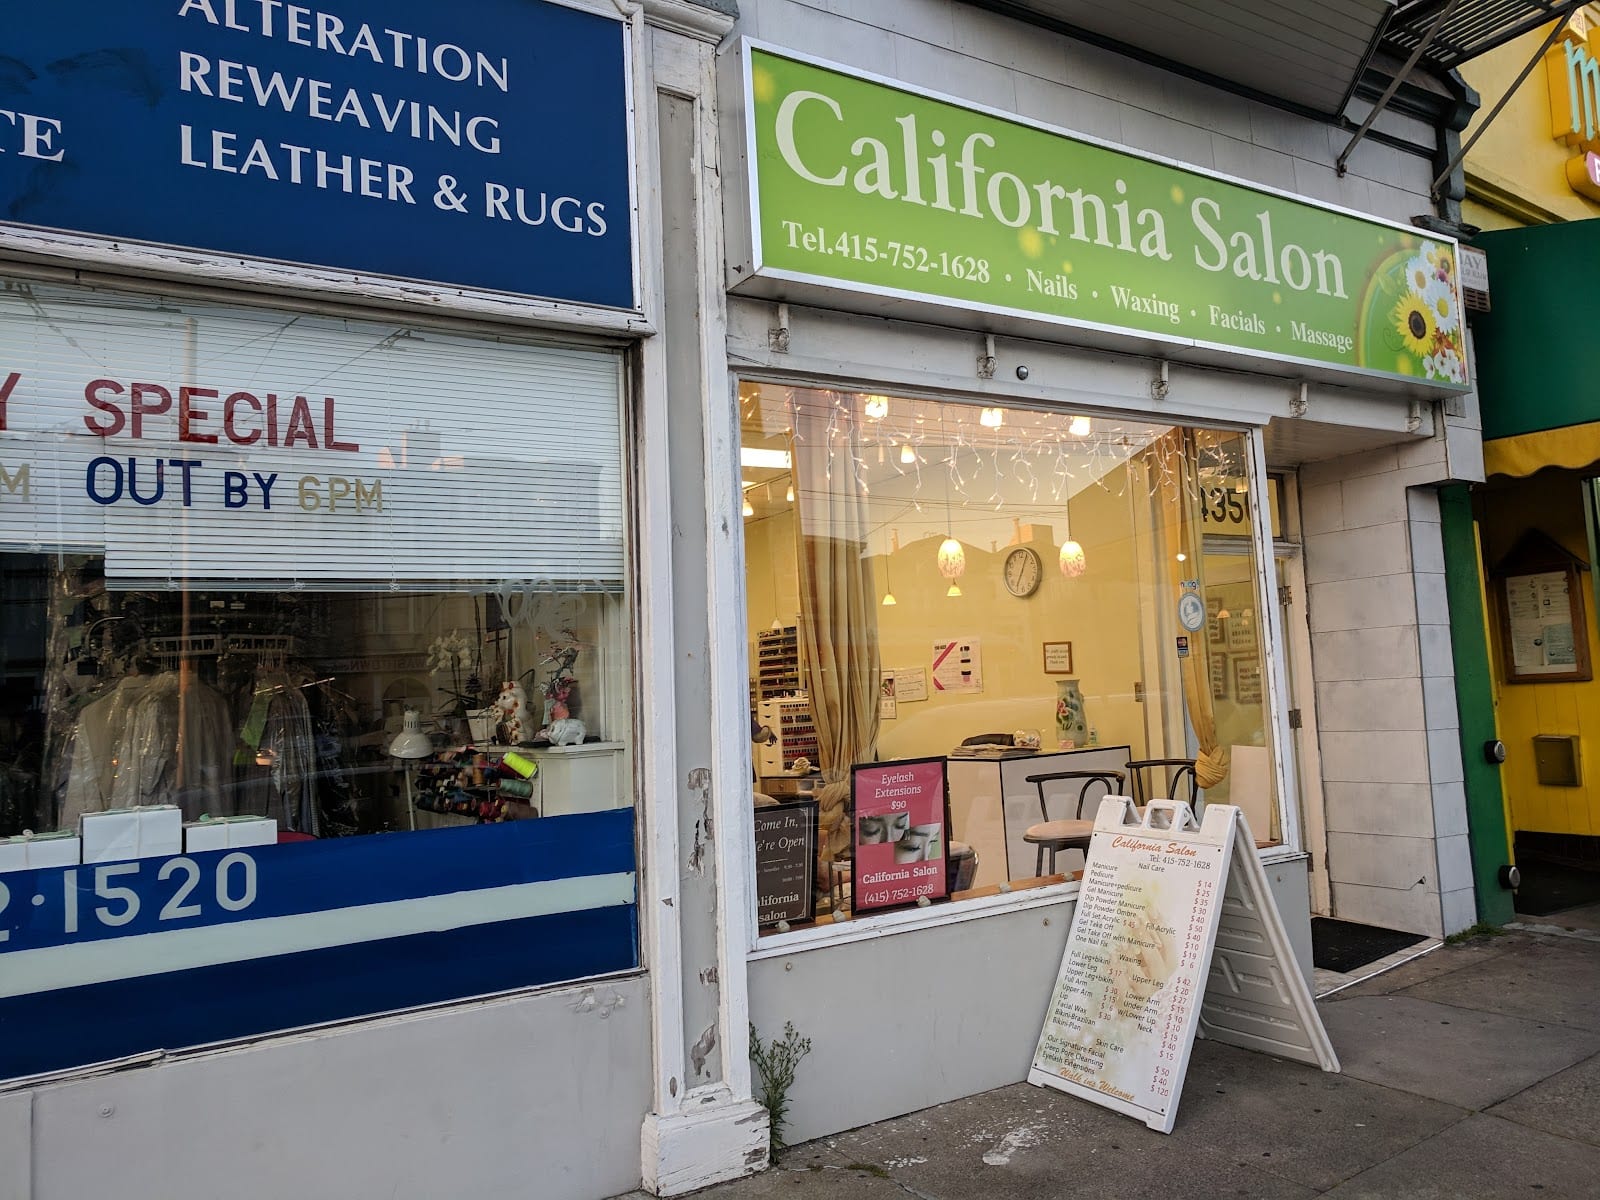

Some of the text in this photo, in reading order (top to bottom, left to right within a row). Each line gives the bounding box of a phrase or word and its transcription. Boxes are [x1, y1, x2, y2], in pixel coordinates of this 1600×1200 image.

[178, 0, 509, 92] ALTERATION
[180, 50, 501, 154] REWEAVING
[181, 124, 608, 237] LEATHER & RUGS
[775, 90, 1349, 300] California Salon
[1026, 268, 1078, 300] Nails
[1110, 285, 1180, 324] Waxing
[1208, 304, 1266, 336] Facials
[1290, 321, 1354, 353] Massage
[83, 379, 360, 453] SPECIAL
[86, 456, 202, 508] OUT
[224, 472, 279, 510] BY
[298, 475, 384, 514] 6PM
[881, 772, 914, 786] Eyelash
[875, 785, 921, 798] Extensions
[891, 801, 907, 810] $90
[754, 816, 799, 831] Come In,
[755, 837, 804, 853] e're Open
[1111, 836, 1197, 856] California Salon
[1092, 862, 1117, 871] Manicure
[1150, 864, 1165, 872] Care
[1162, 856, 1210, 869] 415-752-1628
[863, 866, 938, 884] California Salon
[1090, 870, 1113, 878] Pedicure
[864, 883, 934, 904] (415) 752-1628
[1098, 888, 1122, 897] Manicure
[1095, 896, 1116, 905] Powder
[1118, 900, 1144, 910] Manicure
[759, 911, 787, 922] salon
[1093, 904, 1115, 913] Powder
[1116, 909, 1136, 917] Ombre
[1090, 920, 1102, 928] Take
[1102, 914, 1120, 924] Acrylic
[1155, 925, 1176, 935] Acrylic
[1075, 934, 1108, 947] One Nail Fix
[1087, 928, 1100, 936] Take
[1101, 931, 1111, 939] Off
[1112, 934, 1125, 942] with
[1127, 937, 1155, 948] Manicure
[1068, 959, 1097, 972] Lower Leg
[1118, 954, 1141, 965] Waxing
[1066, 967, 1083, 976] Upper
[1064, 975, 1087, 986] Full Arm
[1132, 974, 1164, 988] Upper Leg
[1059, 991, 1068, 999] Lip
[1062, 983, 1092, 997] Upper Arm
[1125, 991, 1160, 1006] Lower Arm
[1057, 1000, 1087, 1014] Facial Wax
[1123, 1000, 1142, 1011] Under
[1143, 1005, 1158, 1015] Arm
[1145, 1016, 1156, 1025] Lip
[1137, 1023, 1153, 1033] Neck
[1047, 1034, 1105, 1058] Our Signature Facial
[1095, 1038, 1124, 1053] Skin Care
[1044, 1043, 1103, 1068] Deep Pore Cleansing
[1042, 1052, 1094, 1074] Eyelash Extensions
[1059, 1067, 1082, 1082] Walk
[1098, 1080, 1134, 1101] Welcome
